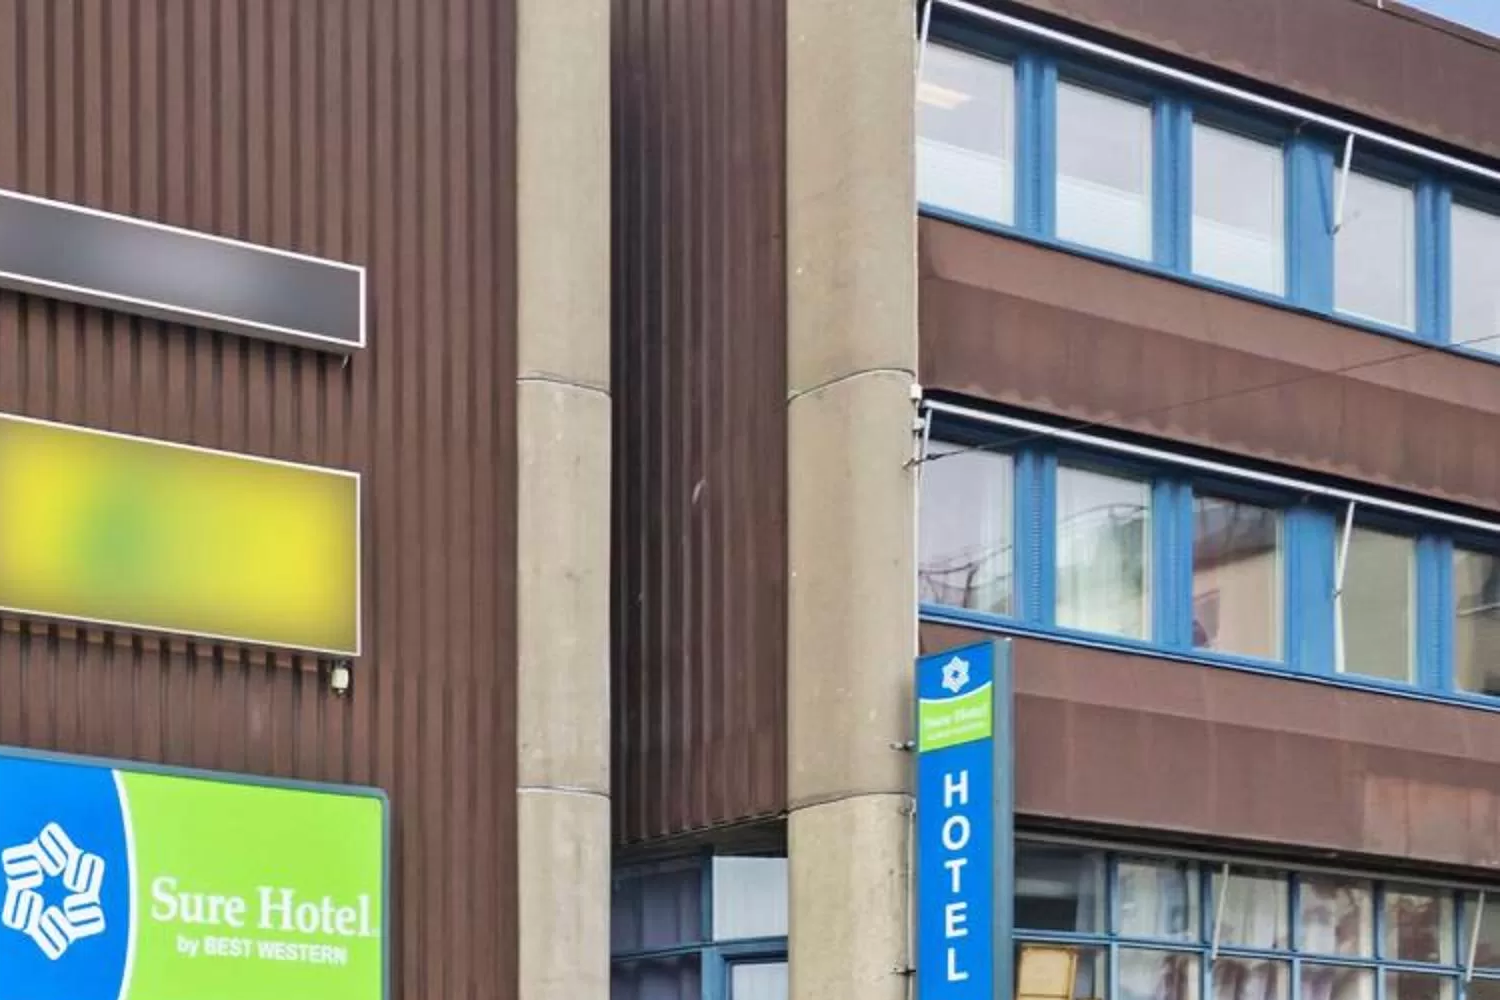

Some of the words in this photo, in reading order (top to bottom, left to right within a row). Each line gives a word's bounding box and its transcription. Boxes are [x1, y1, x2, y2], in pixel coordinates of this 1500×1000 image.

[150, 875, 247, 928] Sure
[256, 885, 372, 937] Hotel
[942, 769, 971, 983] HOTEL
[176, 934, 199, 957] by
[203, 935, 253, 958] BEST
[256, 939, 349, 966] WESTERN
